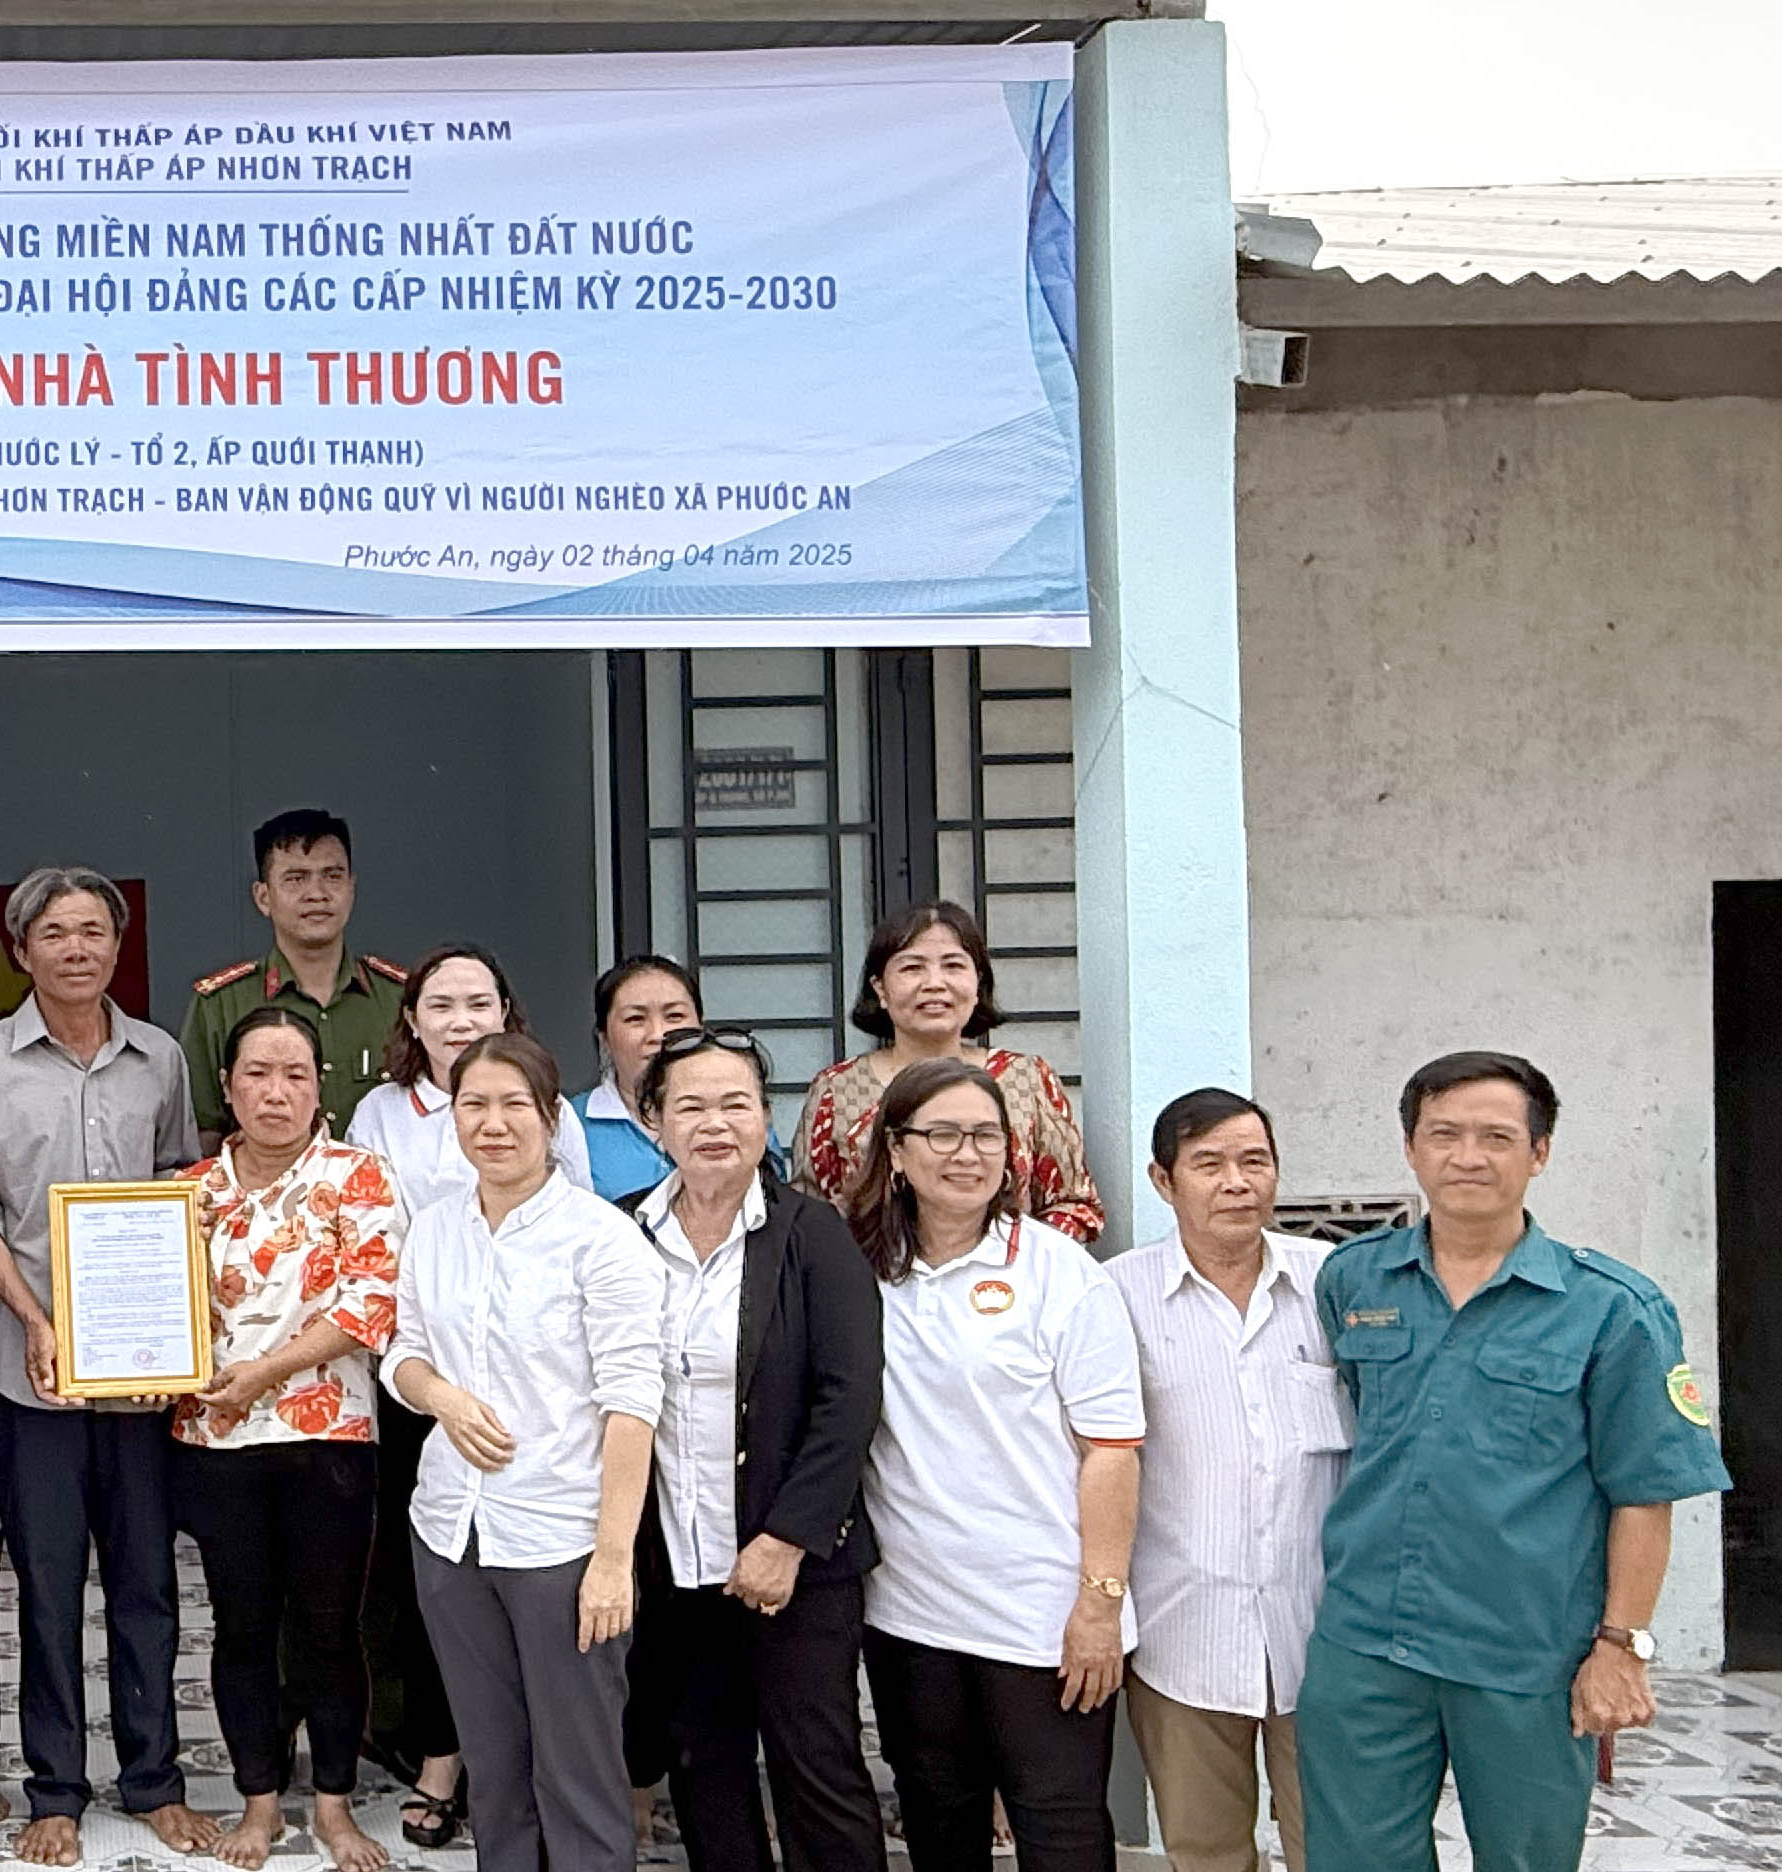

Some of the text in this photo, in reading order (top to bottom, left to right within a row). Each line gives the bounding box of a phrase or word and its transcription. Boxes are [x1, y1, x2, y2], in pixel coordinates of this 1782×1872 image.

[34, 124, 84, 148] KHÍ
[94, 121, 174, 148] THẤP
[184, 123, 224, 146] ÁP
[235, 122, 295, 145] DẦU
[306, 121, 357, 144] KHÍ
[367, 120, 436, 145] VIỆT
[446, 120, 512, 141] NAM
[14, 154, 65, 182] KHÍ
[75, 152, 155, 182] THẤP
[165, 153, 206, 181] ÁP
[217, 154, 301, 181] NHƠN
[311, 154, 412, 183] TRẠCH
[56, 214, 150, 258] MIỀN
[166, 223, 246, 258] NAM
[258, 213, 384, 257] THỐNG
[400, 212, 495, 257] NHẤT
[507, 212, 578, 256] ĐẤT
[591, 214, 694, 256] NƯỚC
[68, 272, 132, 318] HỘI
[146, 267, 248, 312] ĐẢNG
[264, 271, 337, 312] CÁC
[352, 268, 426, 312] CẤP
[441, 269, 562, 316] NHIỆM
[576, 269, 622, 310] KỲ
[635, 274, 837, 311] 2025-2030
[134, 341, 283, 407] TÌNH
[306, 344, 564, 406] THƯƠNG
[70, 437, 101, 466] LÝ
[130, 431, 163, 466] TỔ
[173, 440, 198, 469] 2,
[206, 434, 242, 466] ẤP
[252, 435, 316, 467] QUỚI
[56, 487, 144, 516] TRẠCH
[176, 486, 228, 512] BAN
[238, 482, 289, 515] VẬN
[298, 482, 373, 515] ĐỘNG
[384, 482, 437, 513] QUỸ
[444, 482, 471, 511] VÌ
[482, 481, 564, 512] NGƯỜI
[575, 481, 665, 511] NGHÈO
[674, 482, 708, 511] XÃ
[716, 480, 808, 511] PHƯỚC
[816, 485, 852, 511] AN
[343, 542, 852, 573] Phước An, ngày 02 tháng 04 năm 2025
